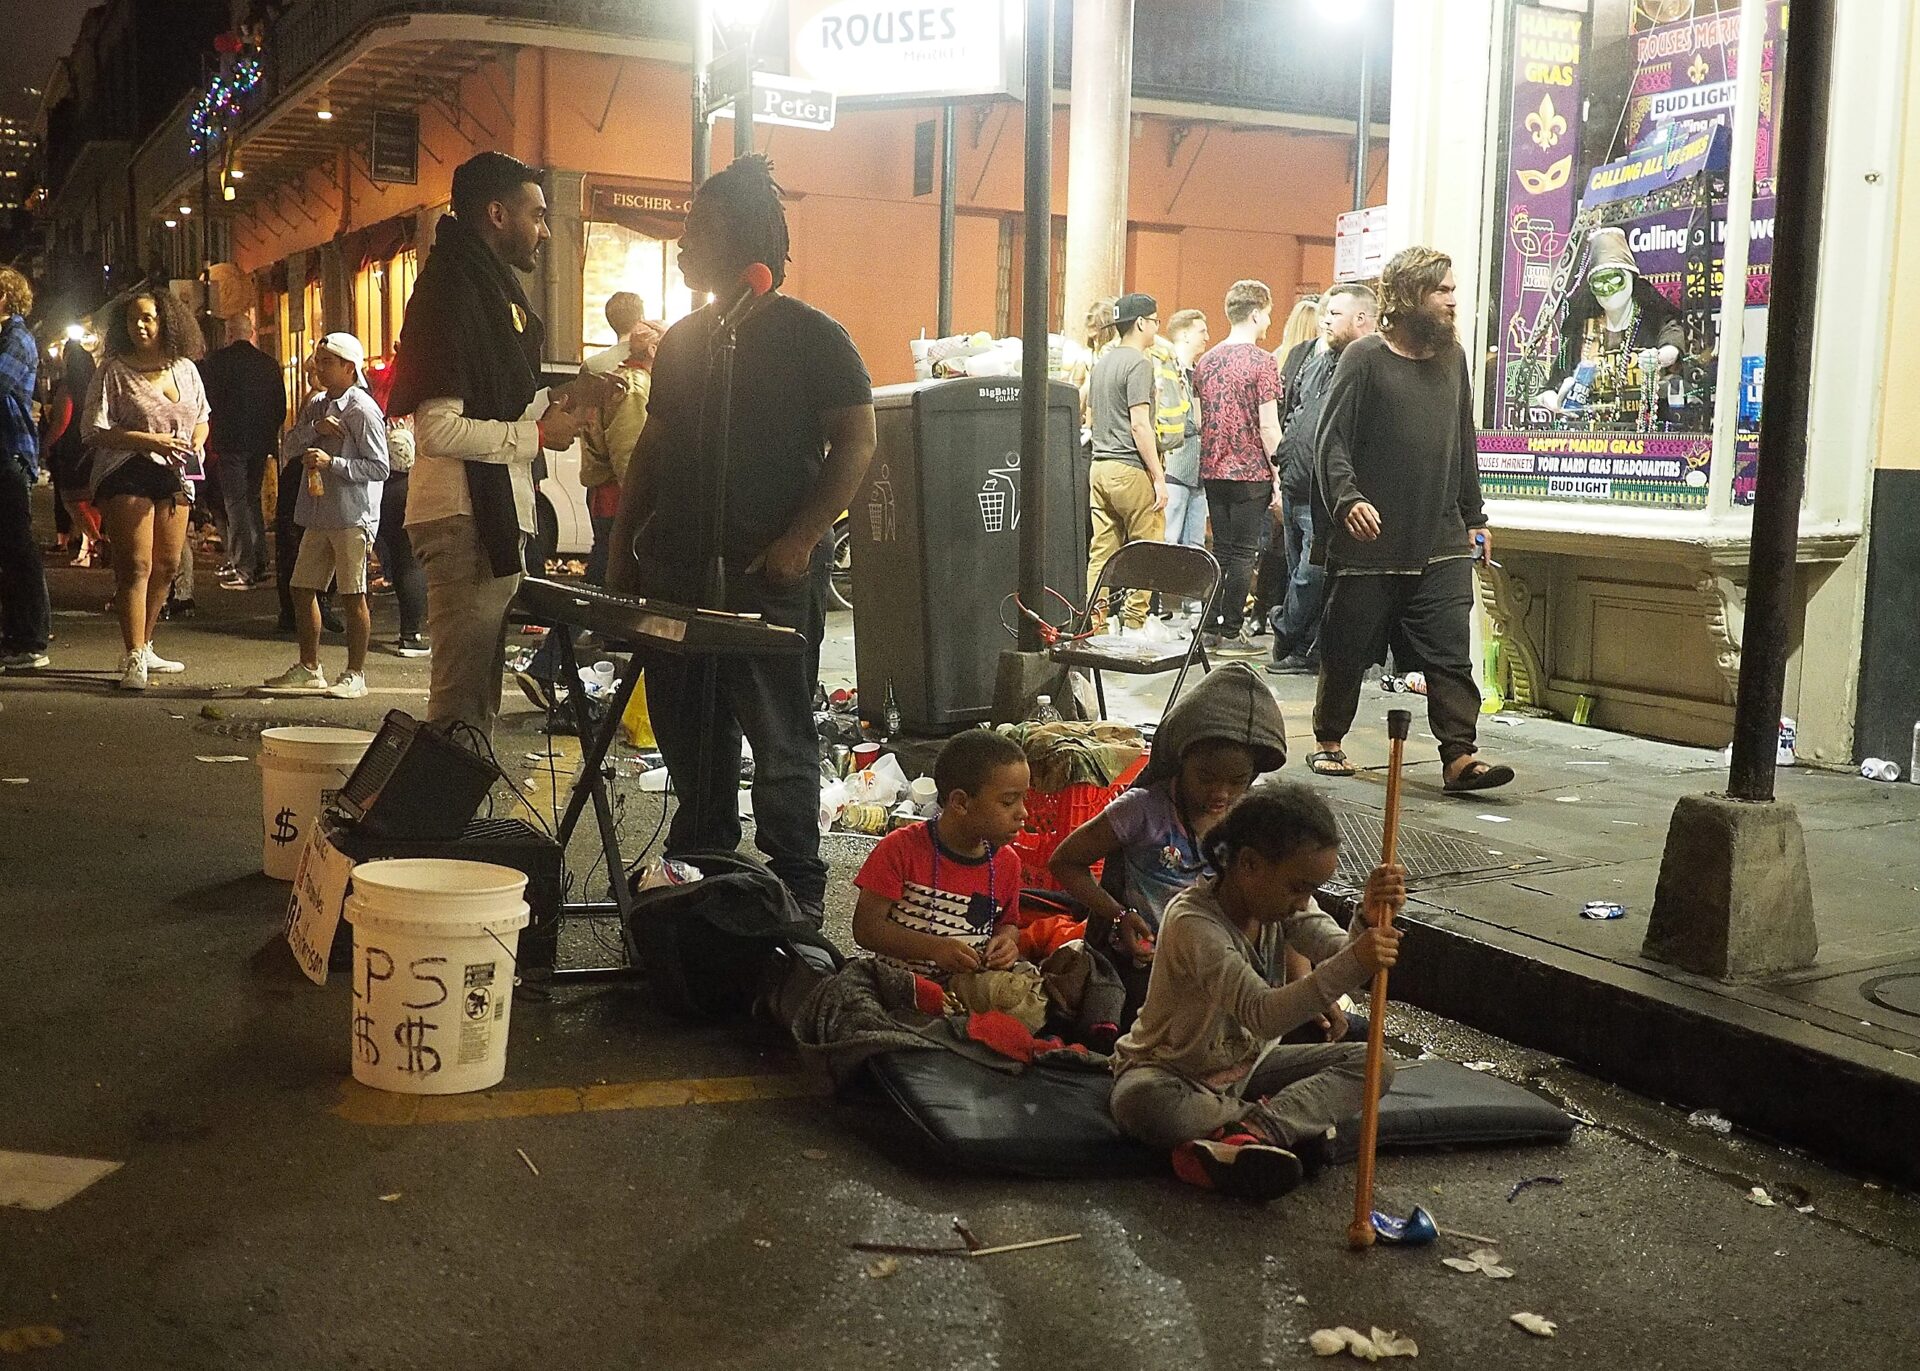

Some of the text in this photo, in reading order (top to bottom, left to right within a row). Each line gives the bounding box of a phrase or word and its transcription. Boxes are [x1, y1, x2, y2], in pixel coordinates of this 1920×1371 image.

[822, 8, 956, 50] ROUSES
[1521, 14, 1582, 40] HAPPY
[1521, 37, 1580, 64] MARDI
[1638, 27, 1692, 63] ROUSES
[1525, 62, 1573, 87] GRAS
[764, 90, 830, 120] Peter
[1655, 95, 1688, 114] BUD
[1591, 162, 1642, 190] CALLING
[1641, 155, 1663, 178] ALL
[613, 193, 672, 211] FISCHER
[1629, 224, 1688, 254] Calling
[979, 387, 1020, 398] BigBelly
[1528, 438, 1645, 455] HAPPY MARDI GRAS
[1479, 457, 1533, 470] OUSES MARKETS
[1538, 457, 1681, 478] YOUR MARDI GRAS HEADQUARTERS
[1551, 480, 1608, 494] BUD LIGHT
